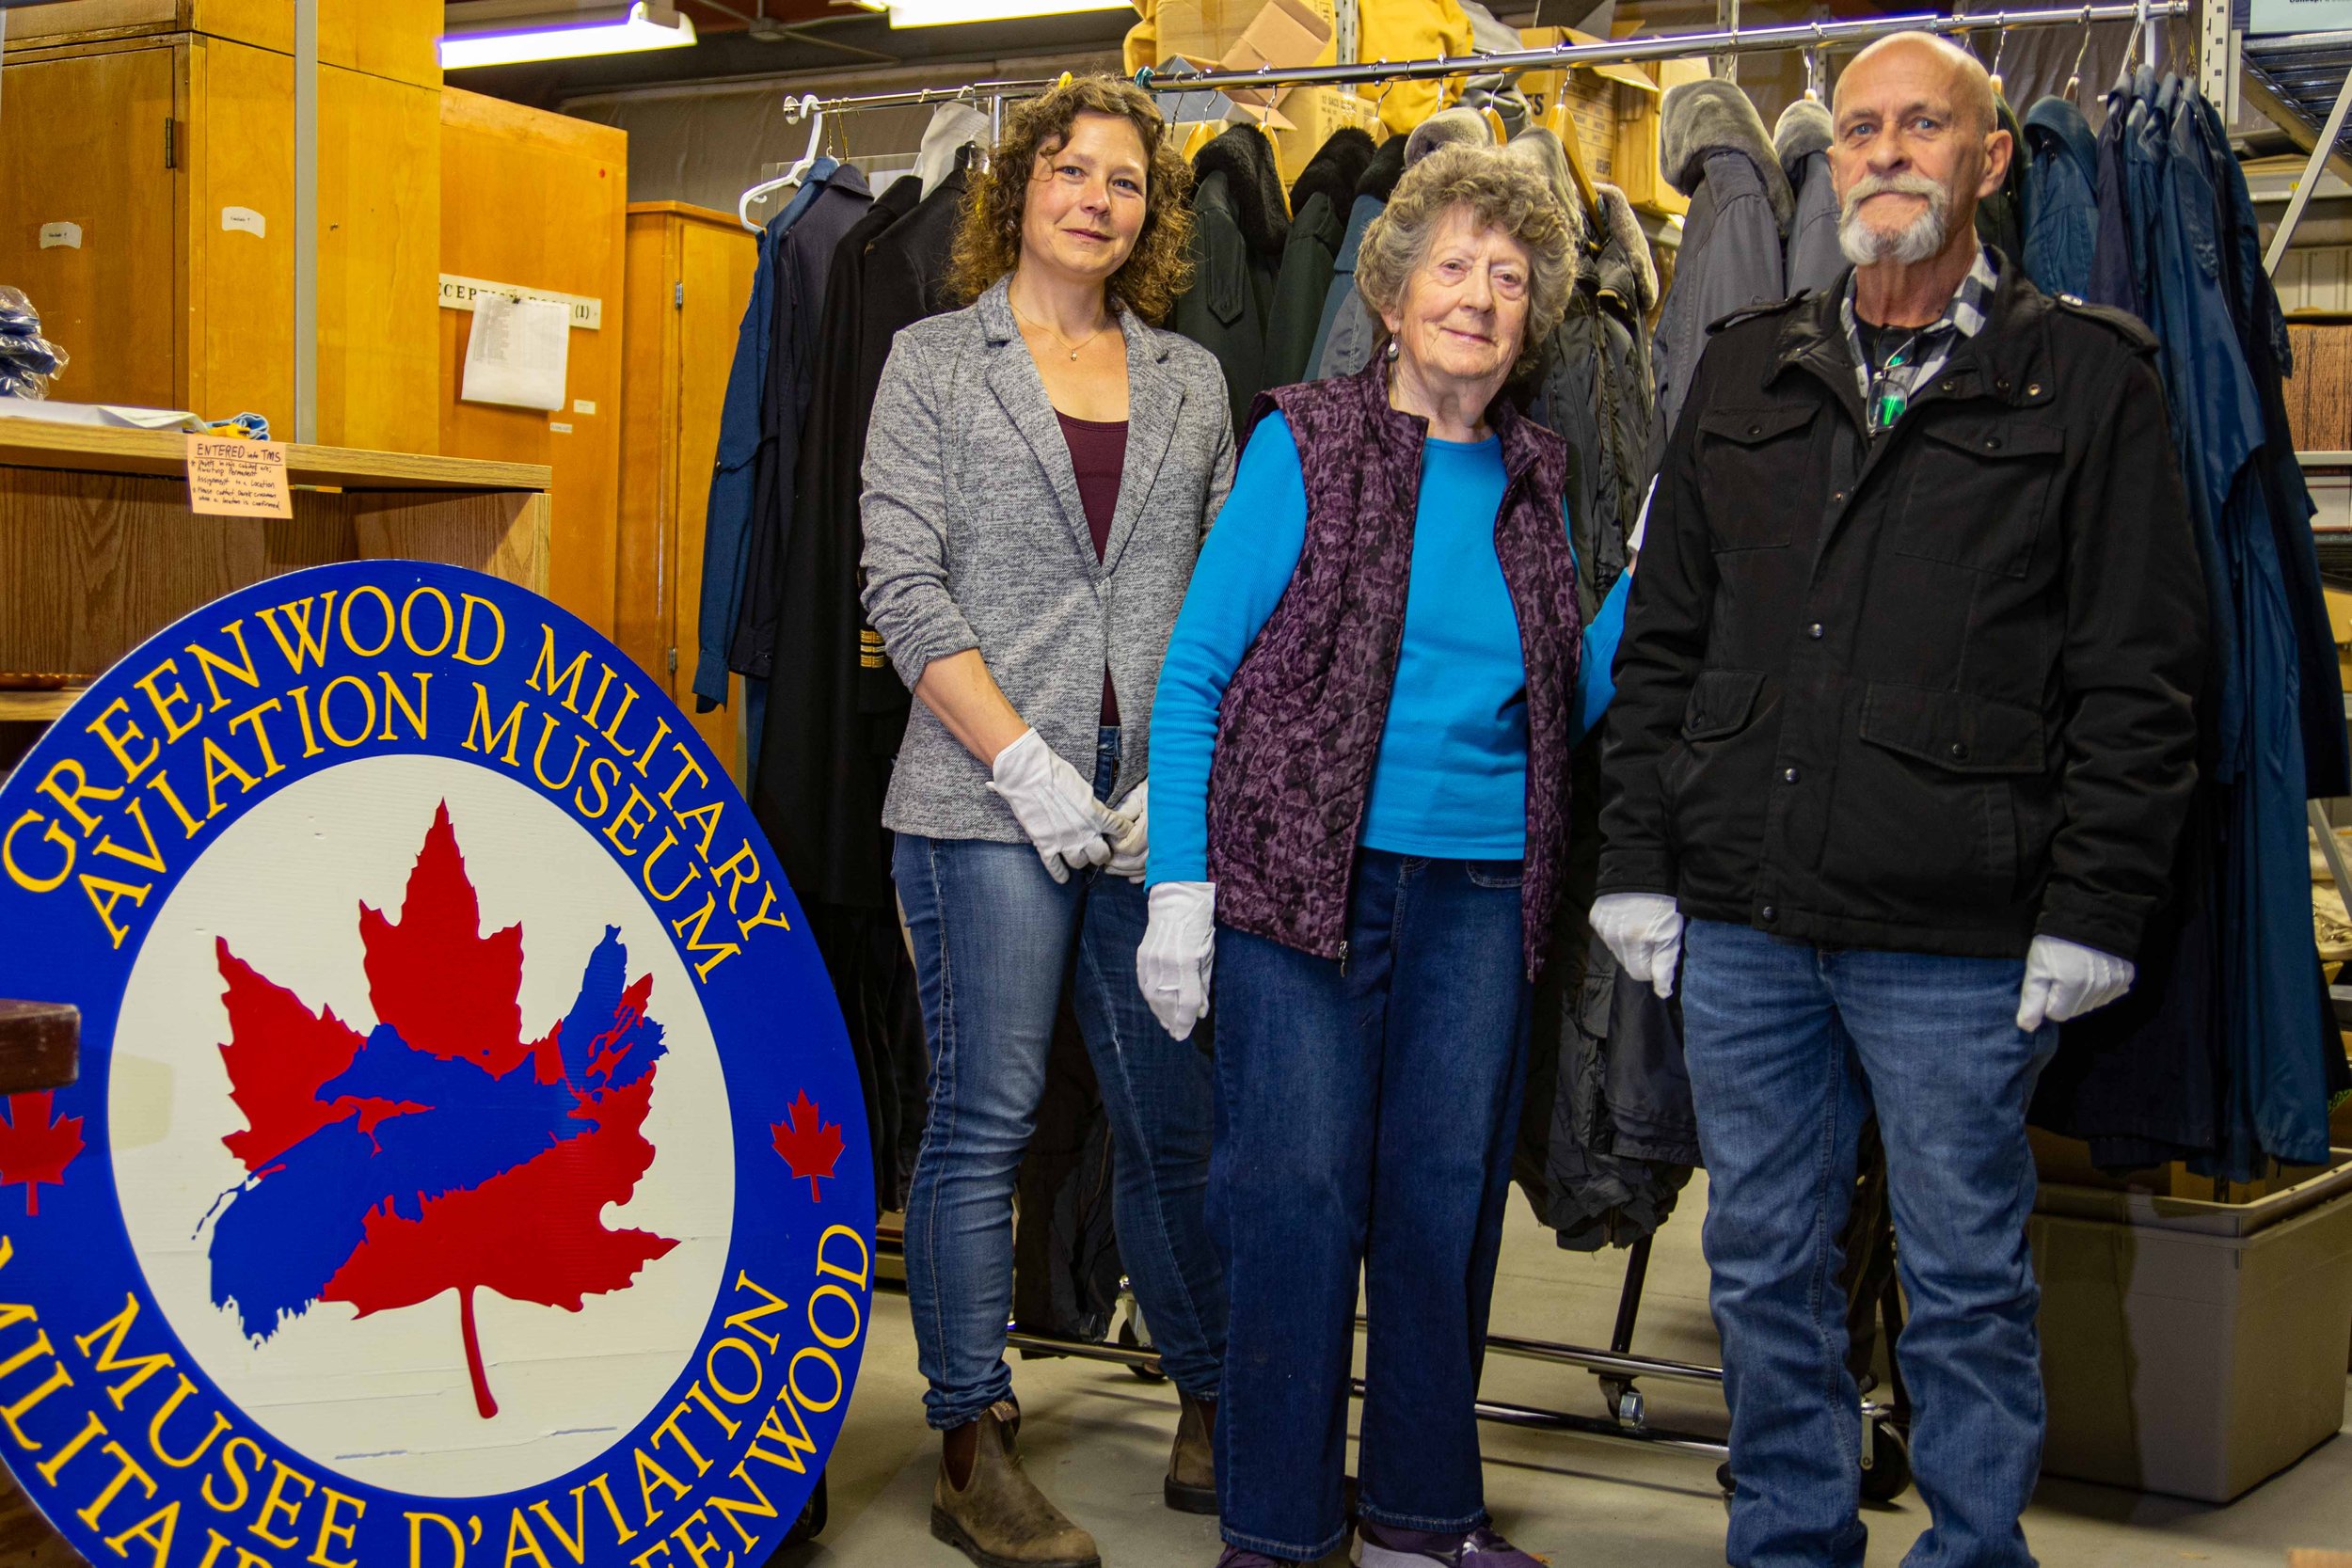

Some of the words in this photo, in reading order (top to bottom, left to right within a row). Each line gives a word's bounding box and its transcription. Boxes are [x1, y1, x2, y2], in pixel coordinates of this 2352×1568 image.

[197, 443, 246, 459] ENTERED
[261, 449, 281, 463] TMS
[3, 585, 505, 893] GREENWOOD
[525, 623, 790, 941] MILITARY
[78, 671, 433, 949] AVIATION
[461, 681, 741, 984] MUSEUM
[75, 1291, 366, 1568] MUSEE
